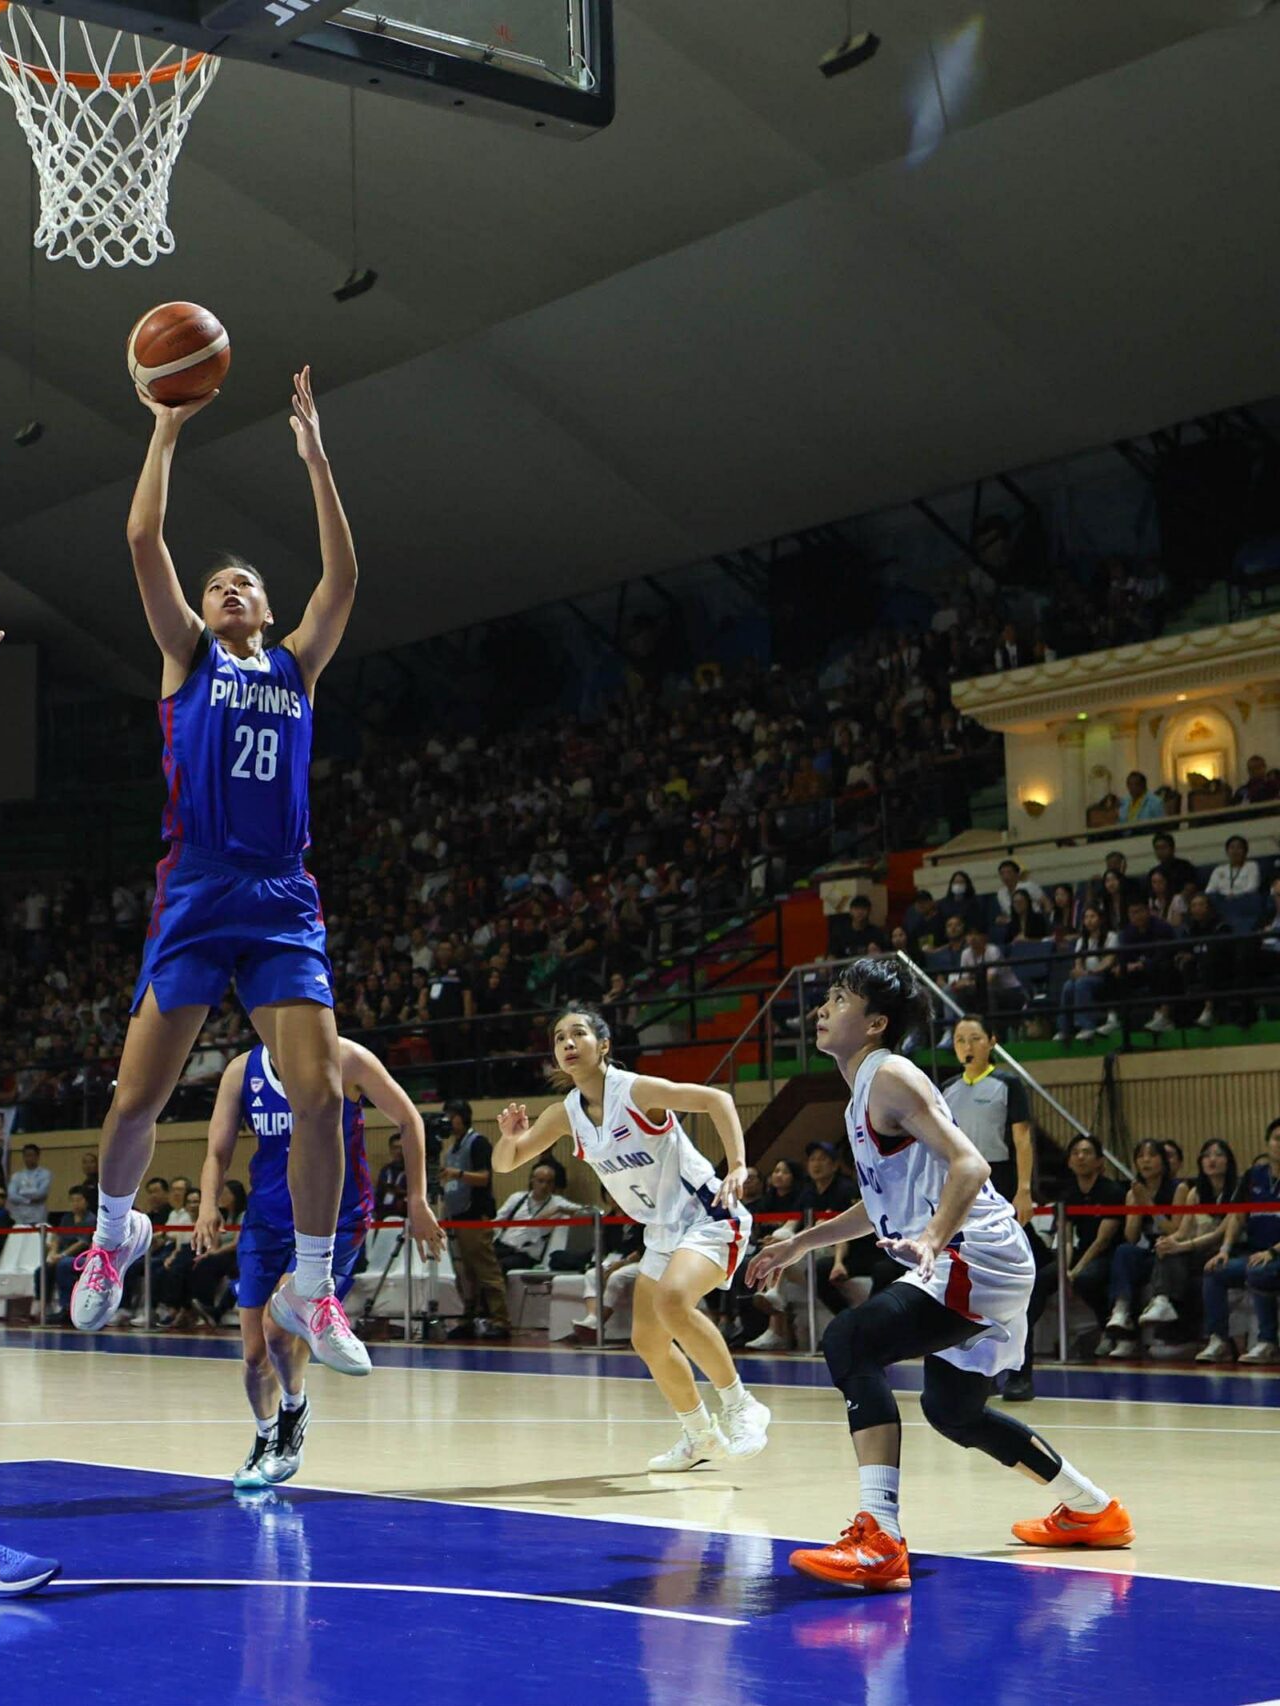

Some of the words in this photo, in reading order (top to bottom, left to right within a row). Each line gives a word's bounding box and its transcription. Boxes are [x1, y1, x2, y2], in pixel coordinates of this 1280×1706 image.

[210, 679, 302, 719] PILIPINAS
[231, 725, 279, 781] 28
[629, 1185, 656, 1209] 6
